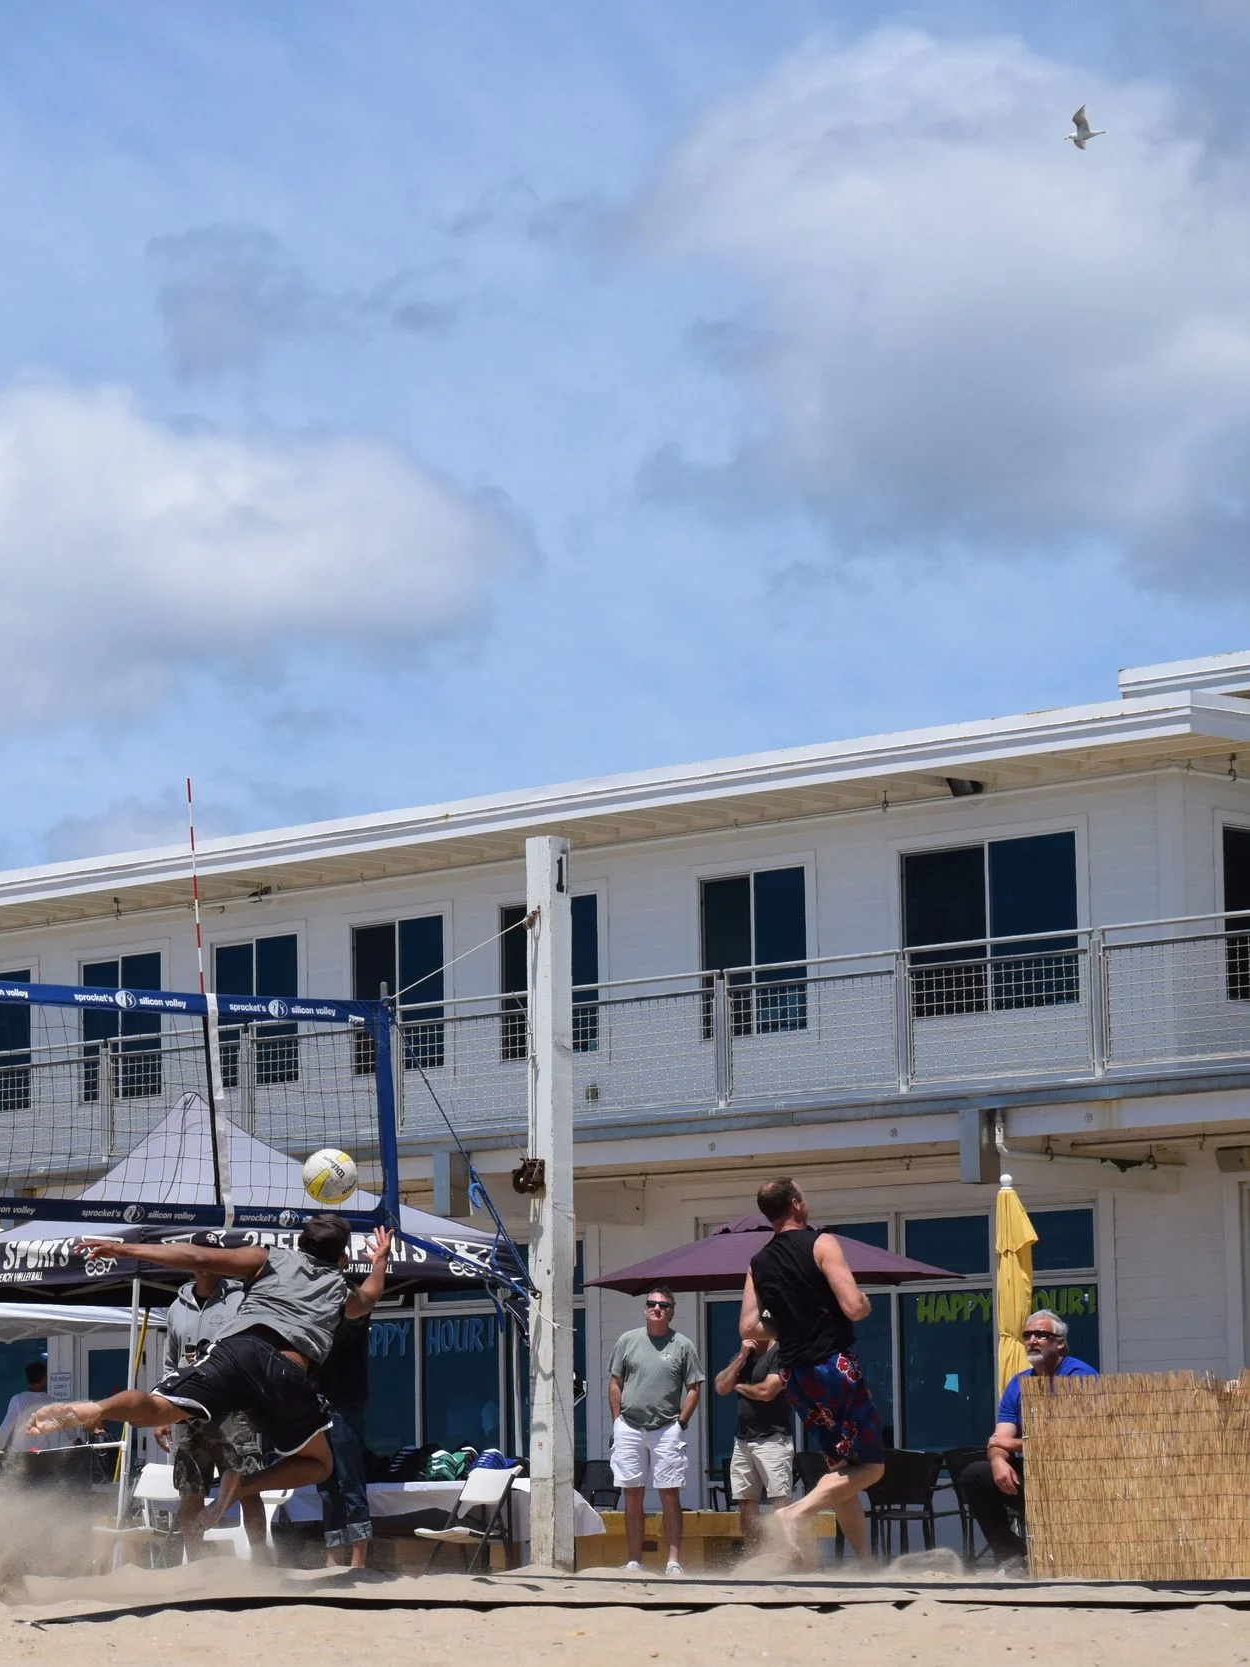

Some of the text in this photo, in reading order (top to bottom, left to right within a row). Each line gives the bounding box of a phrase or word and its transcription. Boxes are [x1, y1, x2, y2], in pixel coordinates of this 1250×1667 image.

[556, 856, 564, 893] 1
[6, 988, 29, 999] volley
[74, 993, 187, 1009] sprocket's silicon volley
[13, 1206, 36, 1217] volley
[81, 1208, 121, 1219] sprocket's
[173, 1213, 196, 1221] volley
[3, 1237, 75, 1270] SPORTS
[354, 1263, 393, 1274] VOLLELL
[13, 1271, 43, 1282] VOLLEYBALL
[916, 1287, 1096, 1324] HAPPY OUR!
[368, 1316, 495, 1358] PPY HOUR!
